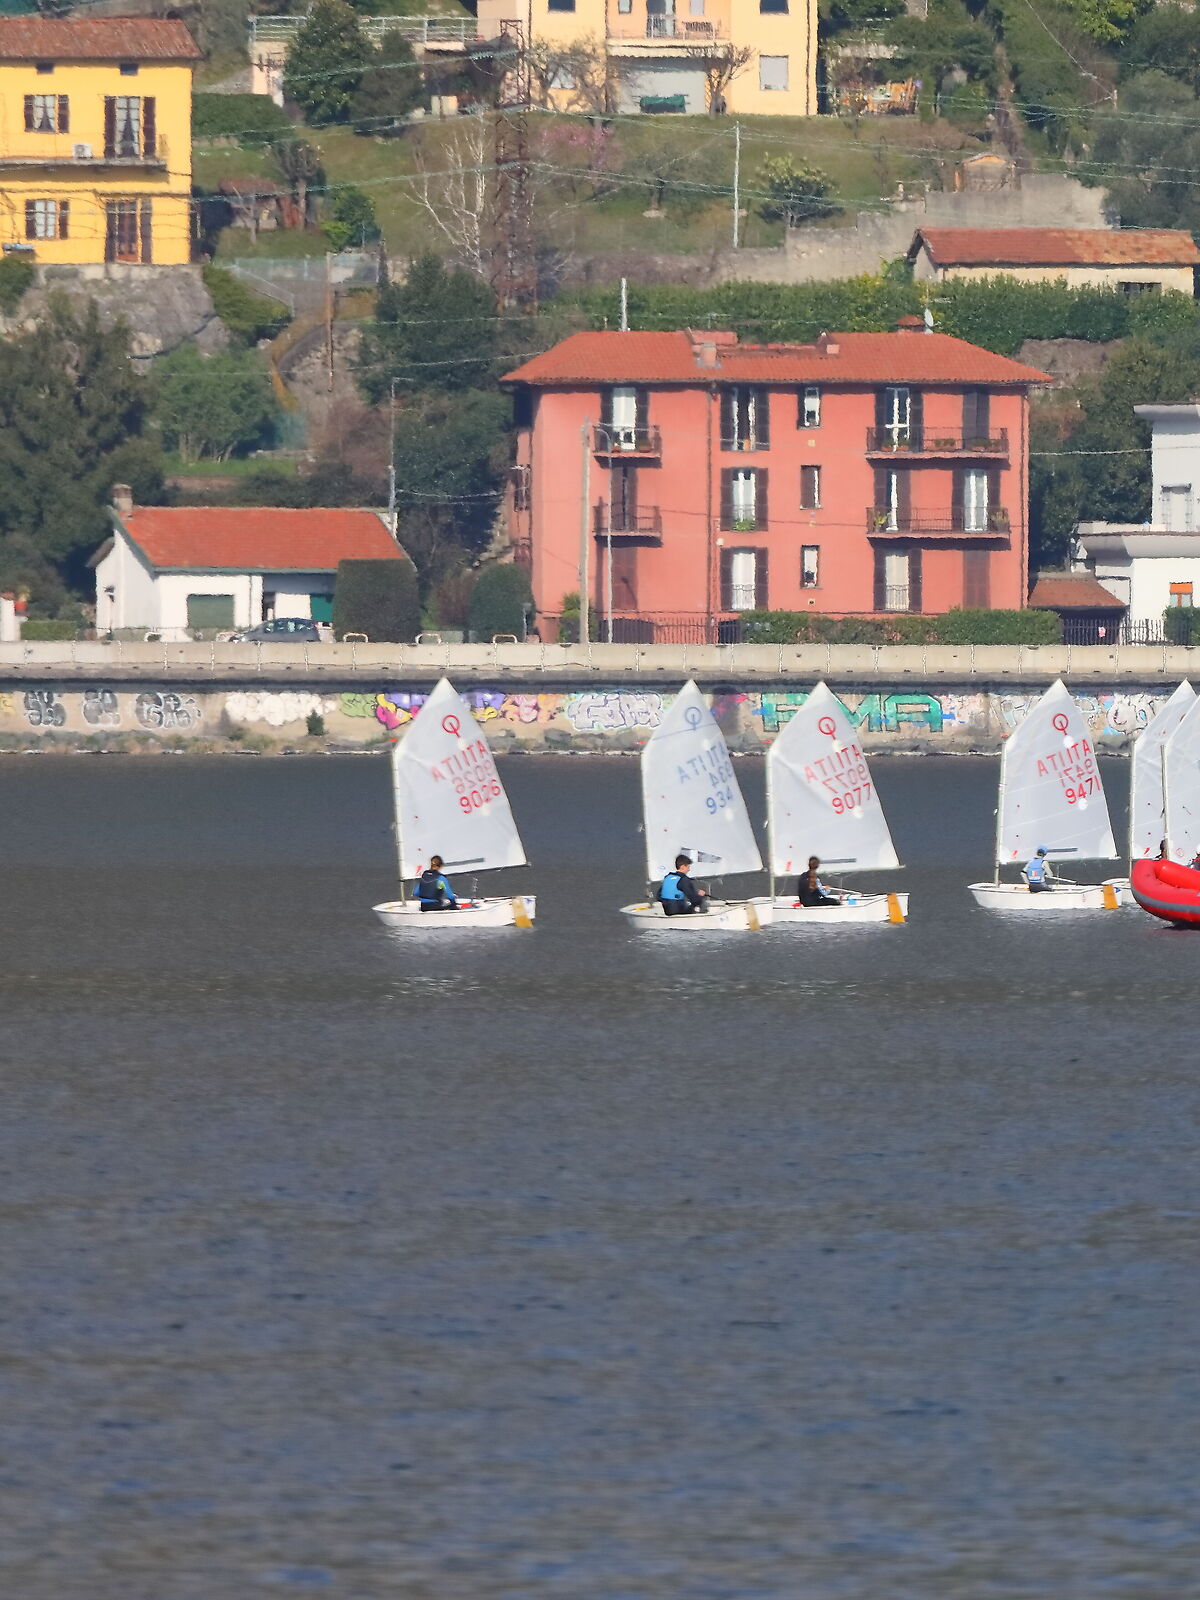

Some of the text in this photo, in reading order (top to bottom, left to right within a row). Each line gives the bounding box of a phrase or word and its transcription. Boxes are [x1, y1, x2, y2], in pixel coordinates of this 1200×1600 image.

[459, 779, 501, 814] 9026
[832, 782, 872, 815] 9077
[1065, 776, 1101, 805] 9471
